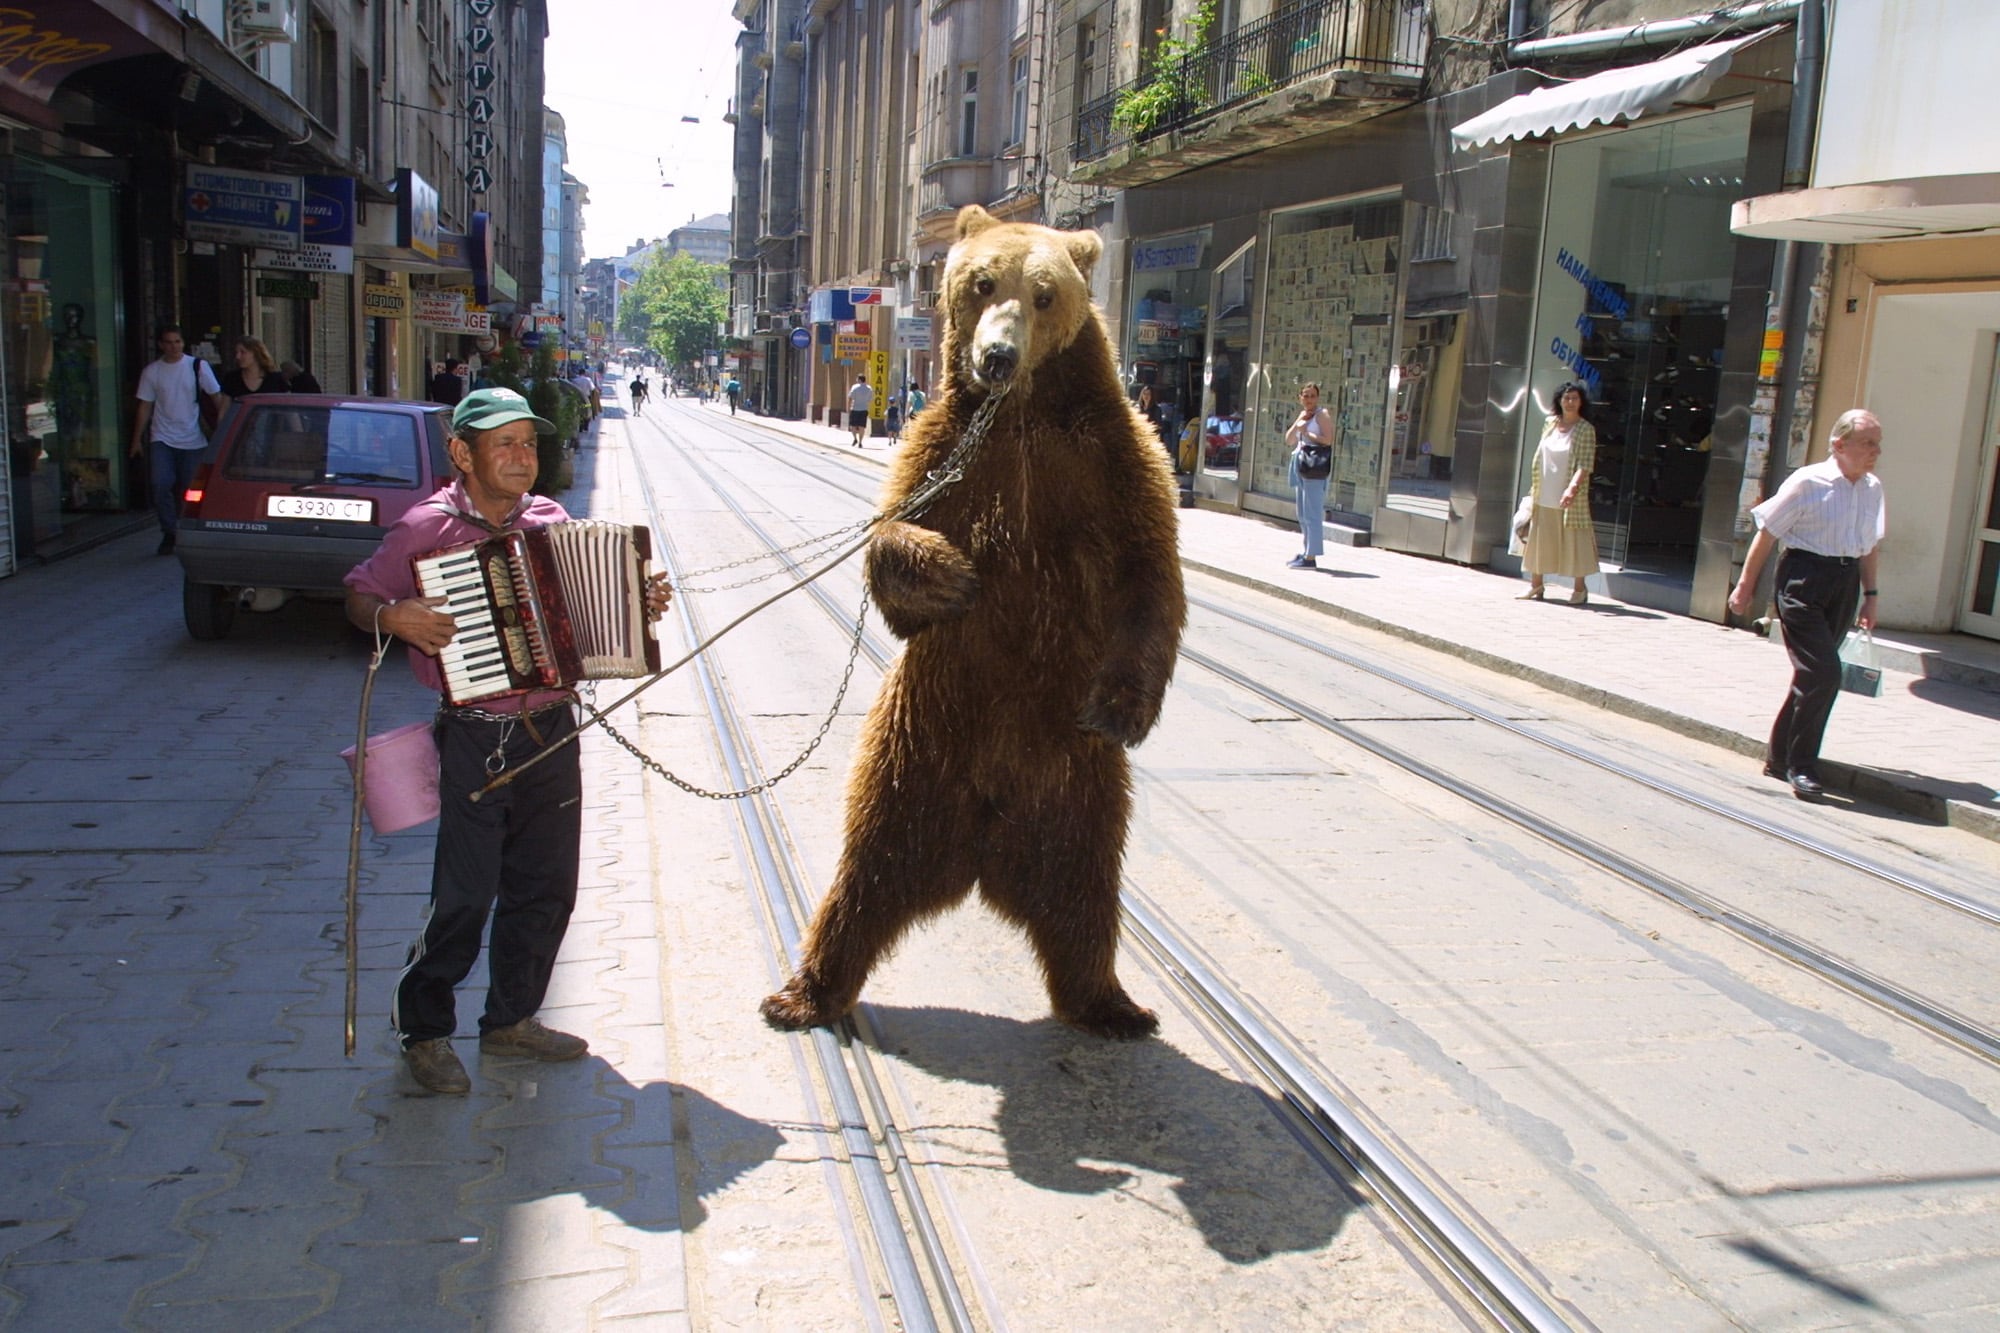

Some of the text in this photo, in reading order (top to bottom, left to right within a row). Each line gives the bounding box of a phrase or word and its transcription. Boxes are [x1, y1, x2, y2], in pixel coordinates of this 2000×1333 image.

[215, 193, 271, 216] КАБИНЕТ
[1145, 244, 1196, 269] Samsonite
[1556, 247, 1630, 321] НАМАЛЕНИЕ
[1575, 312, 1595, 338] НА
[838, 336, 869, 345] CHANGE
[1551, 336, 1601, 387] ОБУВКИ
[874, 353, 884, 418] CHANGE
[294, 500, 336, 517] 3930
[205, 520, 245, 530] RENAULT
